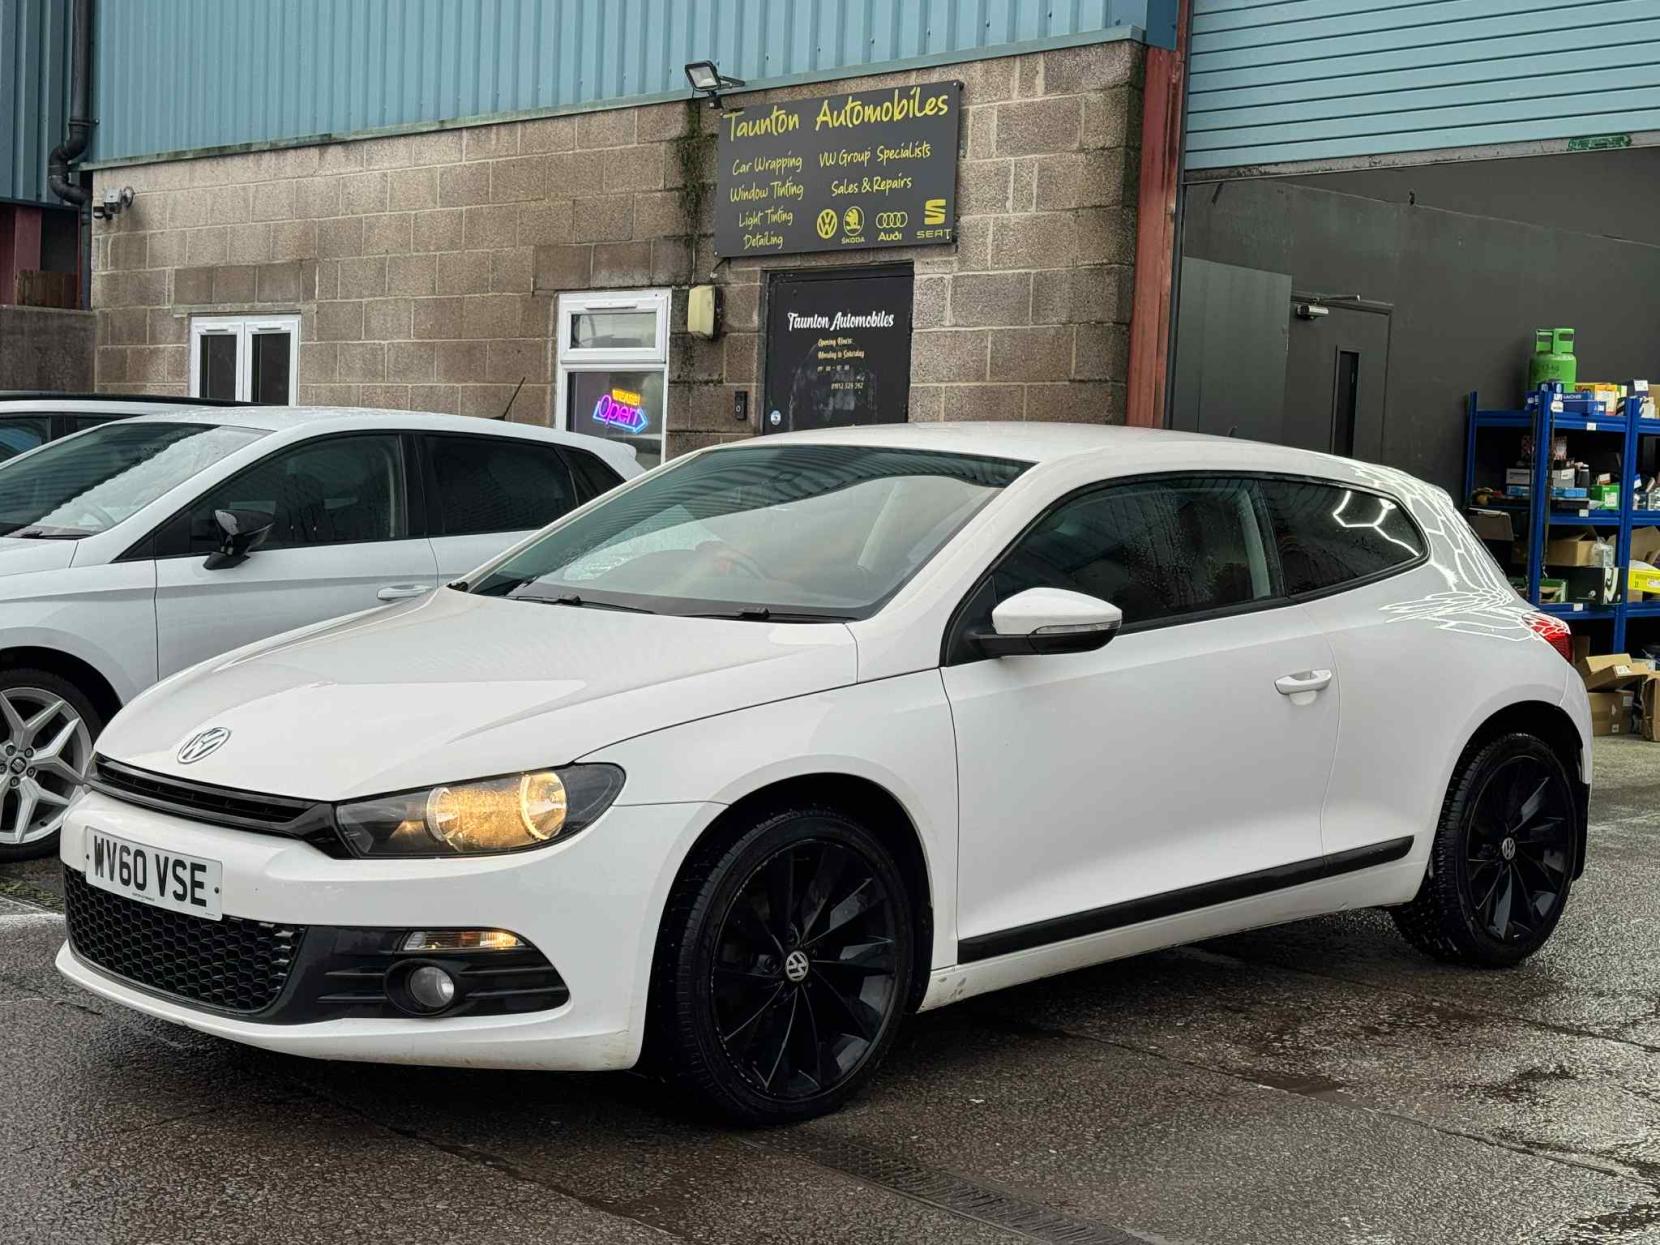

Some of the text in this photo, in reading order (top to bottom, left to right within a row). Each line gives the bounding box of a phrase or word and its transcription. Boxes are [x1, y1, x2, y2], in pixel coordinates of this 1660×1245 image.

[723, 87, 949, 142] Taunton Automobiles
[732, 150, 802, 175] Car Wrapping
[819, 140, 931, 168] VW Group Specialists
[730, 176, 803, 202] Window Tinting
[831, 172, 912, 197] Sales & Repairs
[738, 205, 793, 230] Light Tinting
[743, 231, 783, 250] Detailing
[877, 231, 902, 241] Audi
[916, 229, 951, 240] SEAT
[787, 309, 895, 332] Taunton Automobiles
[598, 394, 640, 425] Open
[94, 835, 207, 908] WV60 VSE
